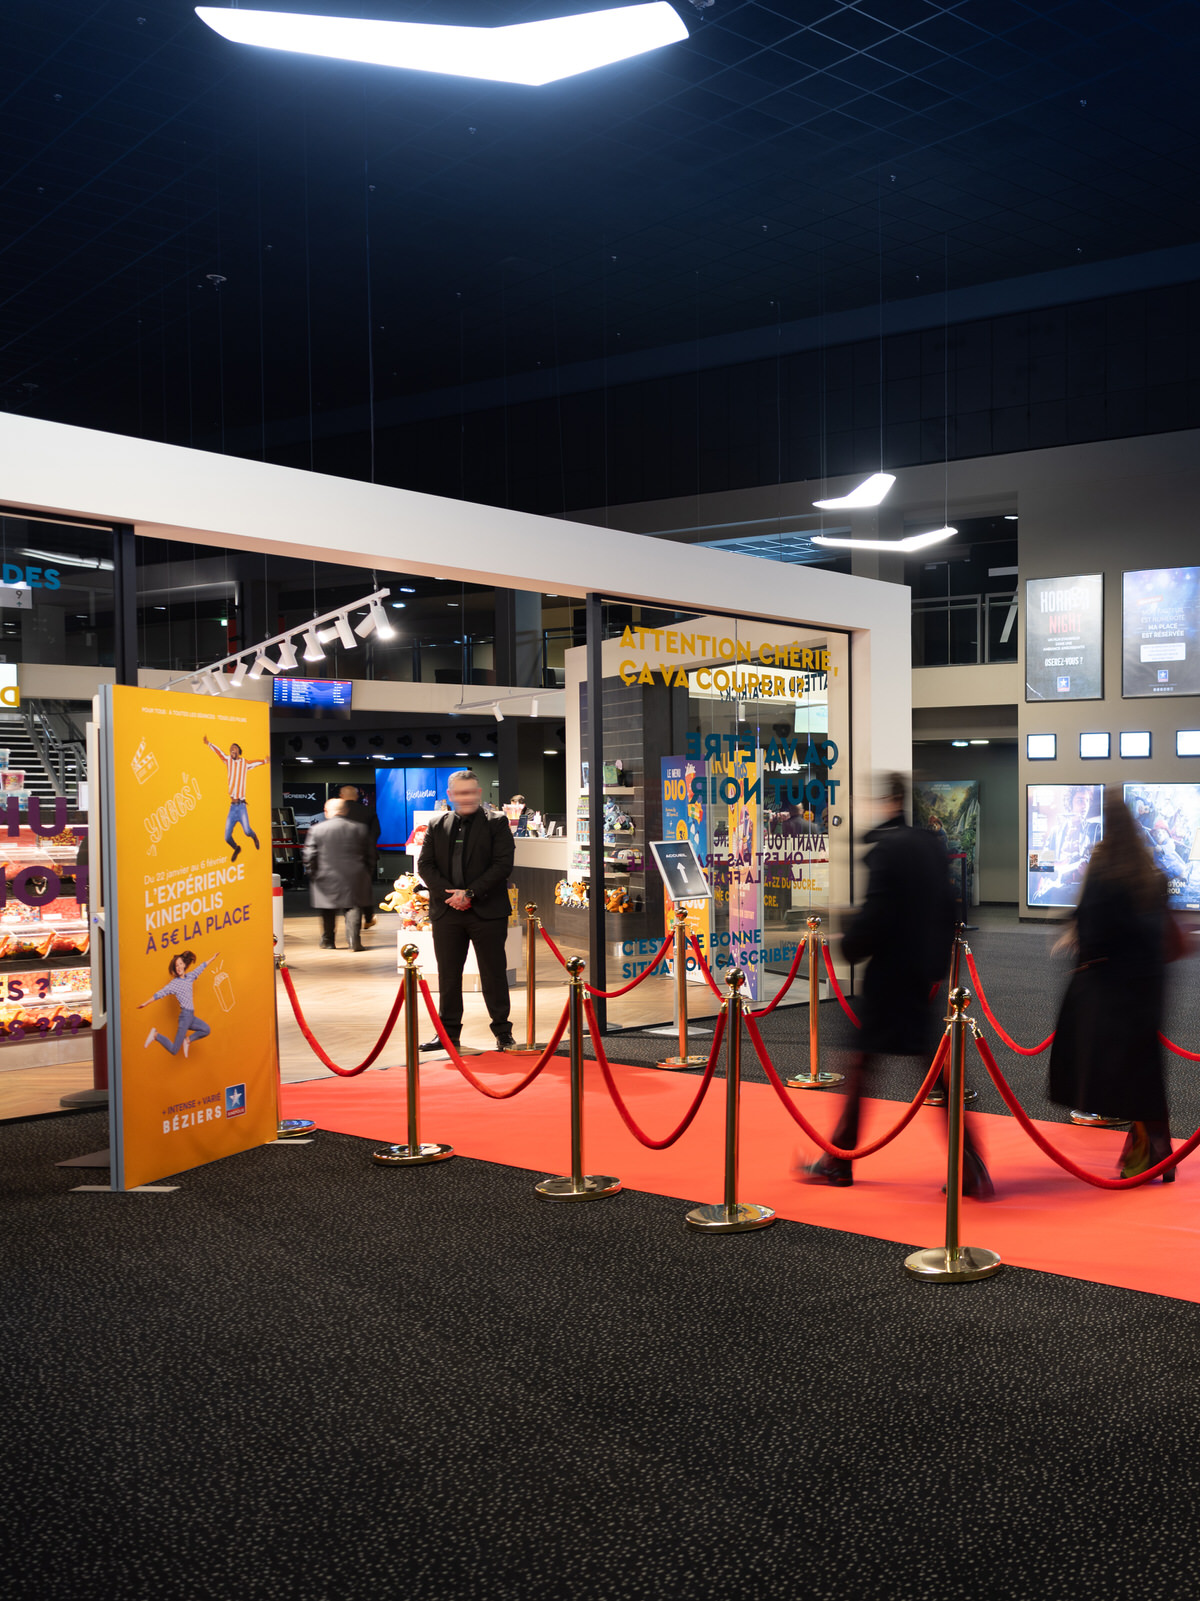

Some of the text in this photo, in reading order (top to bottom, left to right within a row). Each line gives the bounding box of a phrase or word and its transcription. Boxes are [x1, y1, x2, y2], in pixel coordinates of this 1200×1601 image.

[1049, 613, 1082, 634] NIGHT
[619, 625, 839, 677] ATTENTION CHÉRIE,
[619, 660, 655, 687] ÇA
[659, 664, 690, 688] VA
[696, 667, 786, 697] COUPER
[664, 779, 686, 801] DUO
[144, 856, 228, 885] Du 22 janvier au 6 février
[145, 863, 245, 908] L'EXPÉRIENCE
[145, 891, 224, 931] KINEPOLIS
[146, 932, 157, 955] À
[160, 928, 180, 949] 5€
[184, 921, 202, 941] LA
[622, 937, 667, 956] C'EST
[709, 929, 762, 948] BONNE
[715, 951, 736, 971] ÇA
[739, 946, 797, 966] SCRIBE?
[168, 1100, 196, 1114] INTENSE
[202, 1092, 221, 1104] VARIÉ
[163, 1105, 222, 1134] BÉZIERS
